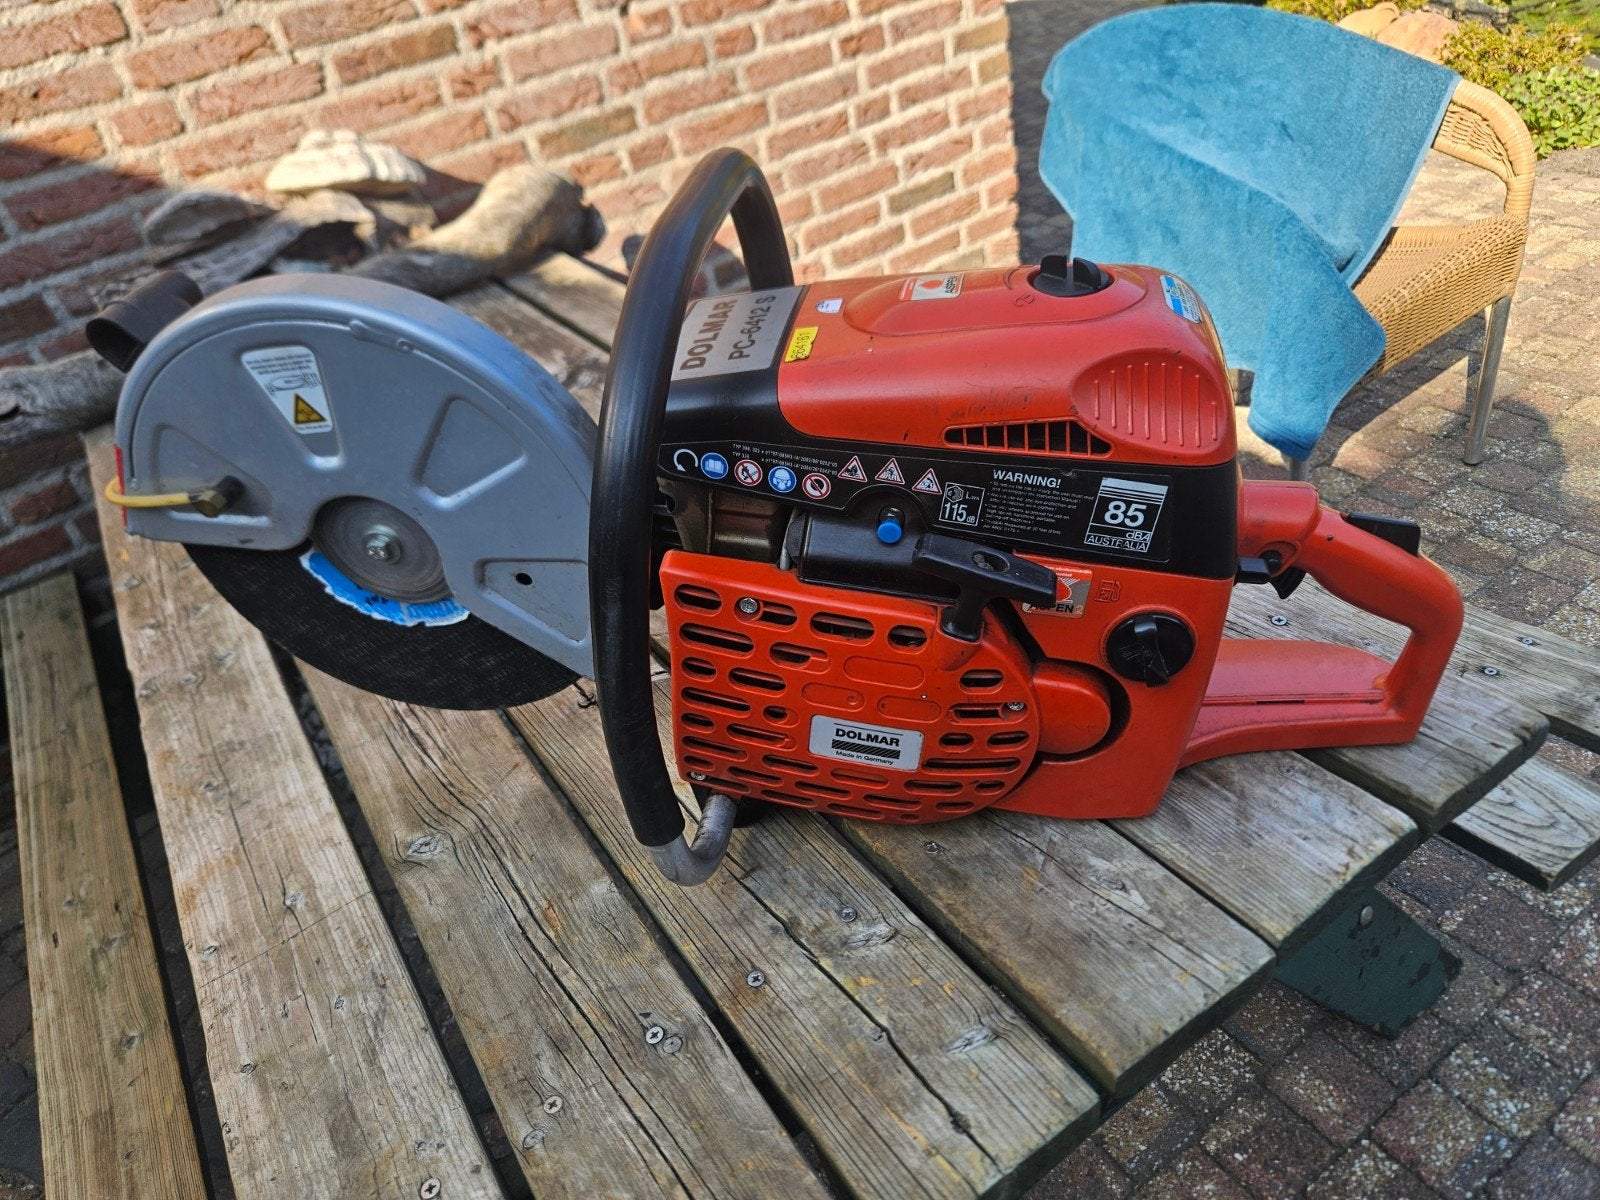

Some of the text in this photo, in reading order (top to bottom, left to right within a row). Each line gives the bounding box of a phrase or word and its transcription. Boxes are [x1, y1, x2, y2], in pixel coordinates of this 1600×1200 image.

[680, 299, 738, 371] DOLMAR
[728, 295, 777, 361] PC-6412 S
[993, 469, 1061, 488] WARNING!
[944, 502, 968, 522] 115
[966, 516, 976, 524] dB
[1104, 500, 1147, 527] 85
[1126, 530, 1152, 542] dBA
[835, 728, 900, 747] DOLMAR
[835, 750, 855, 759] Made
[864, 755, 895, 766] Germany
